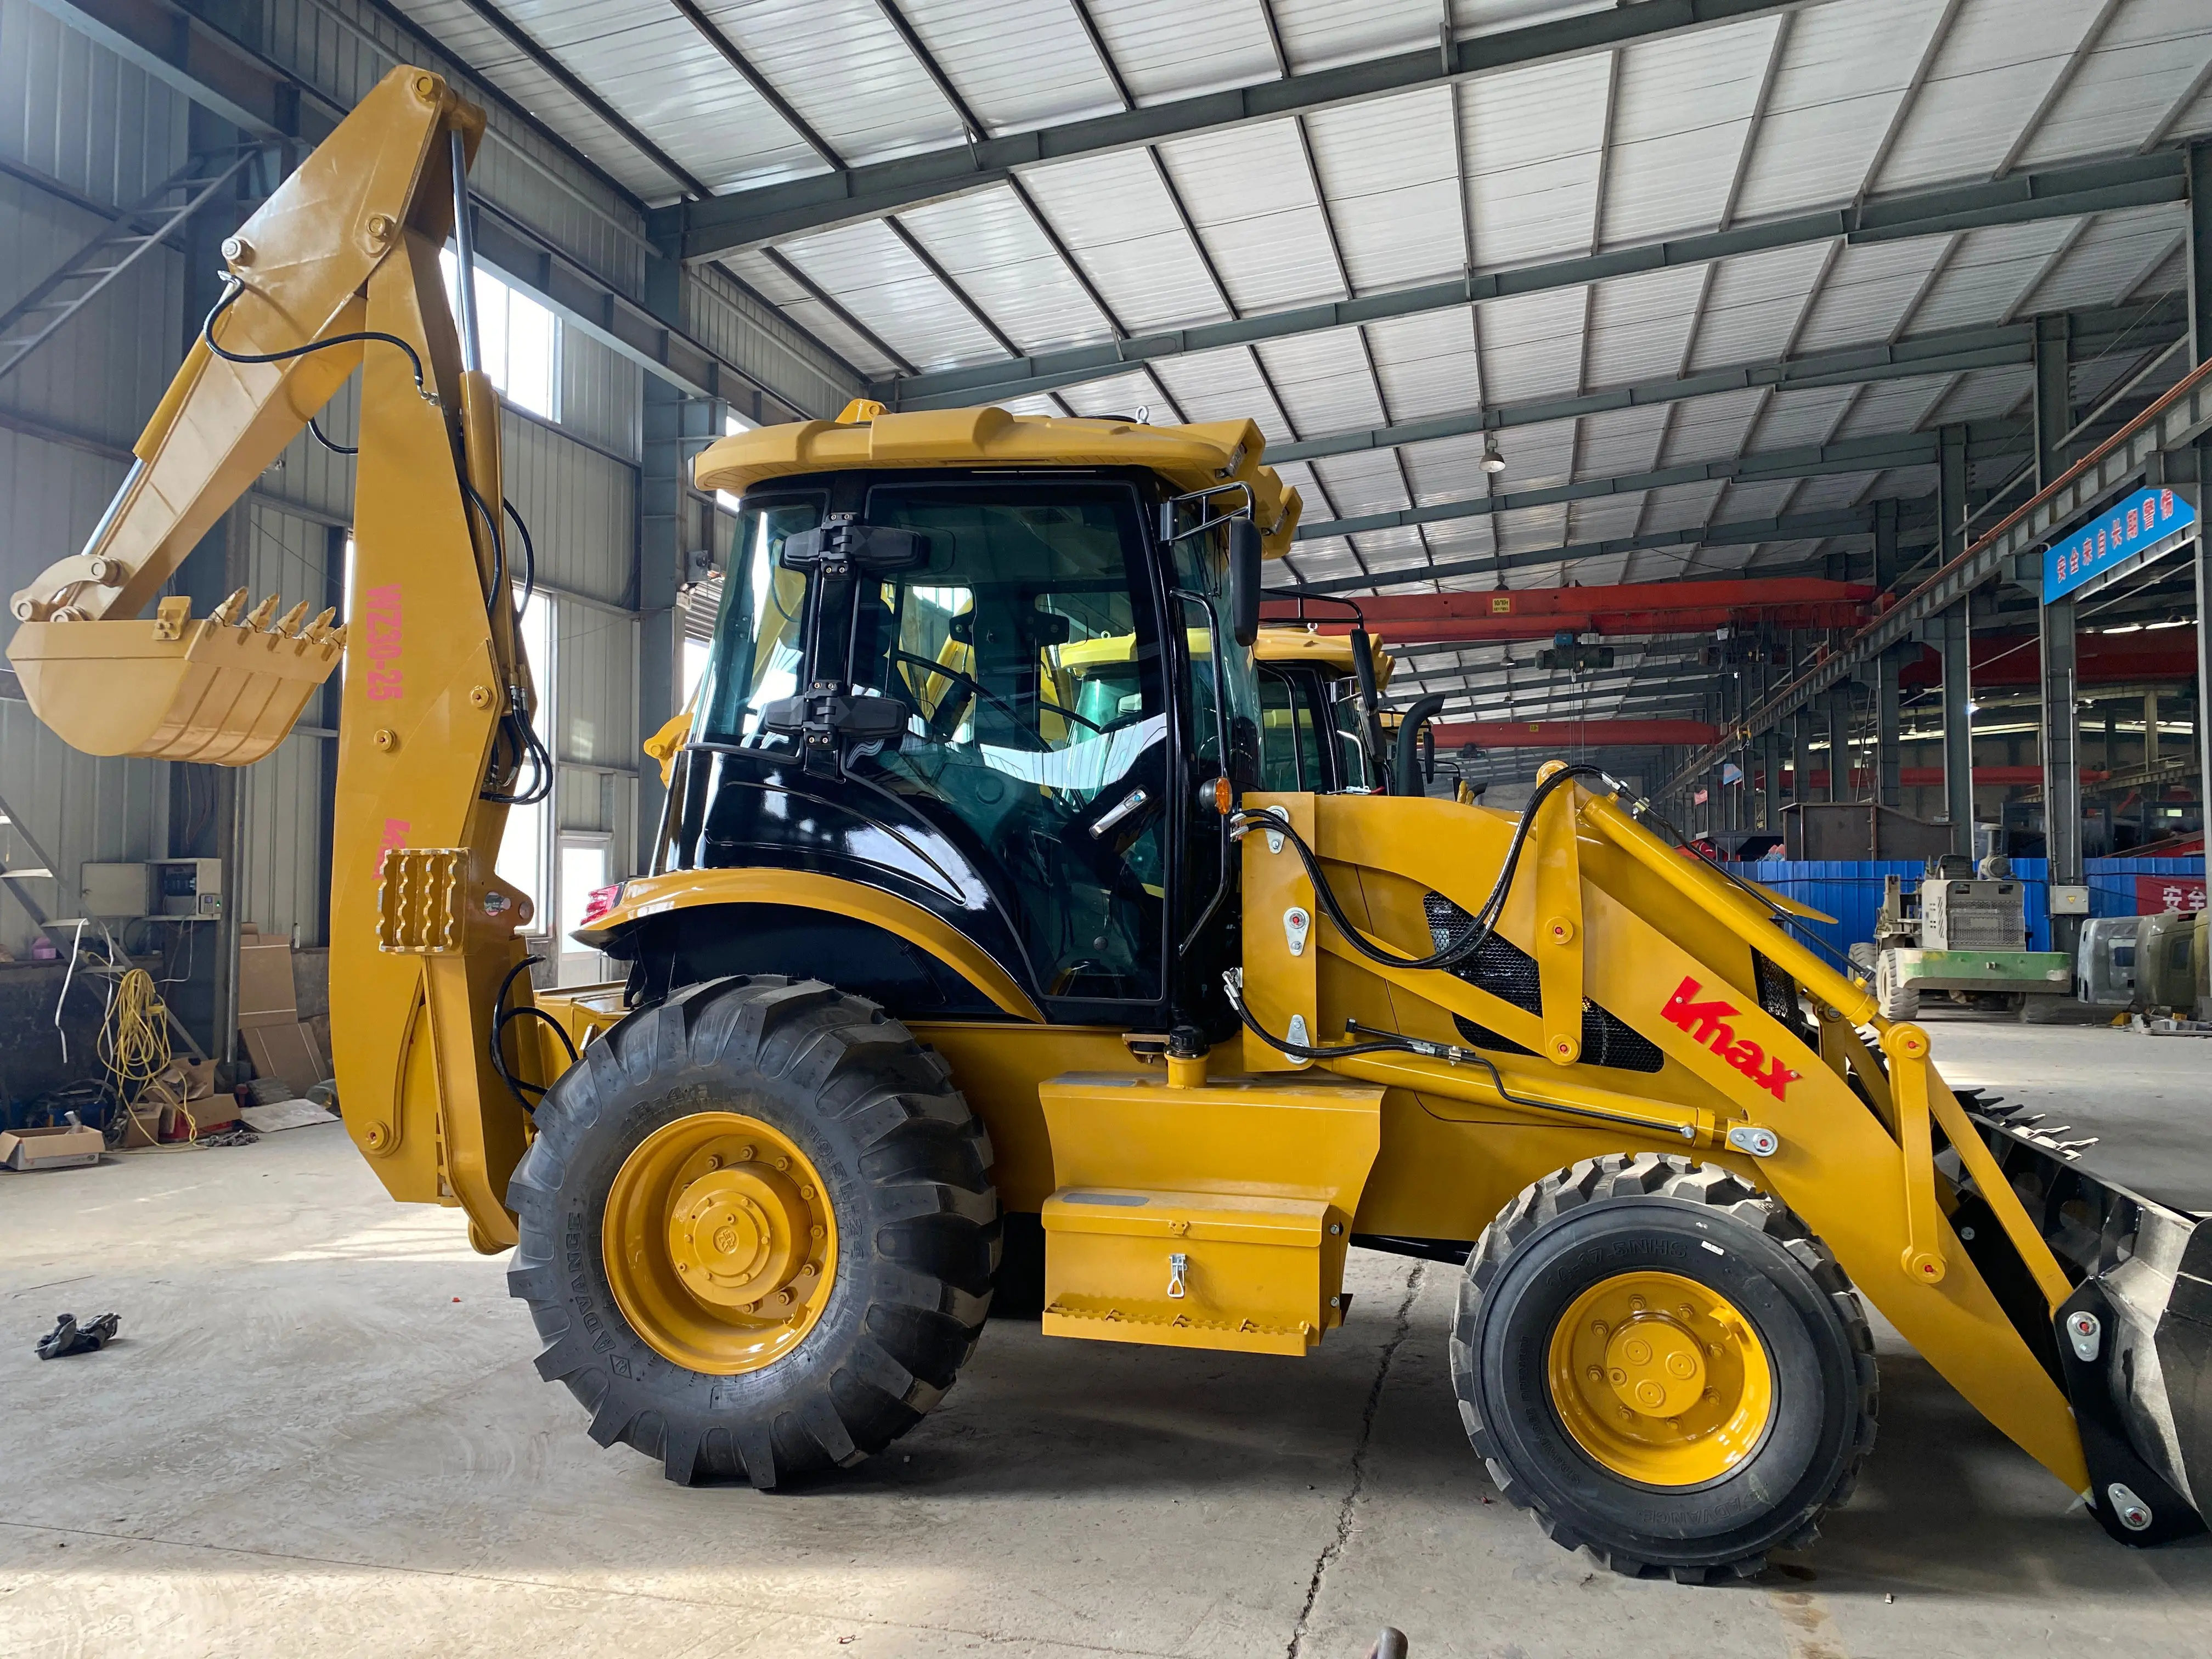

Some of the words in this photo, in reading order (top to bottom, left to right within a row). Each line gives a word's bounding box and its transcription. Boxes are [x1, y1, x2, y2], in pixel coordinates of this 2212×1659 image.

[366, 583, 403, 701] WZ30-25
[2163, 885, 2207, 912] 安全
[566, 1211, 616, 1355] ADVANCE
[1643, 1496, 1742, 1525] ADVANCE
